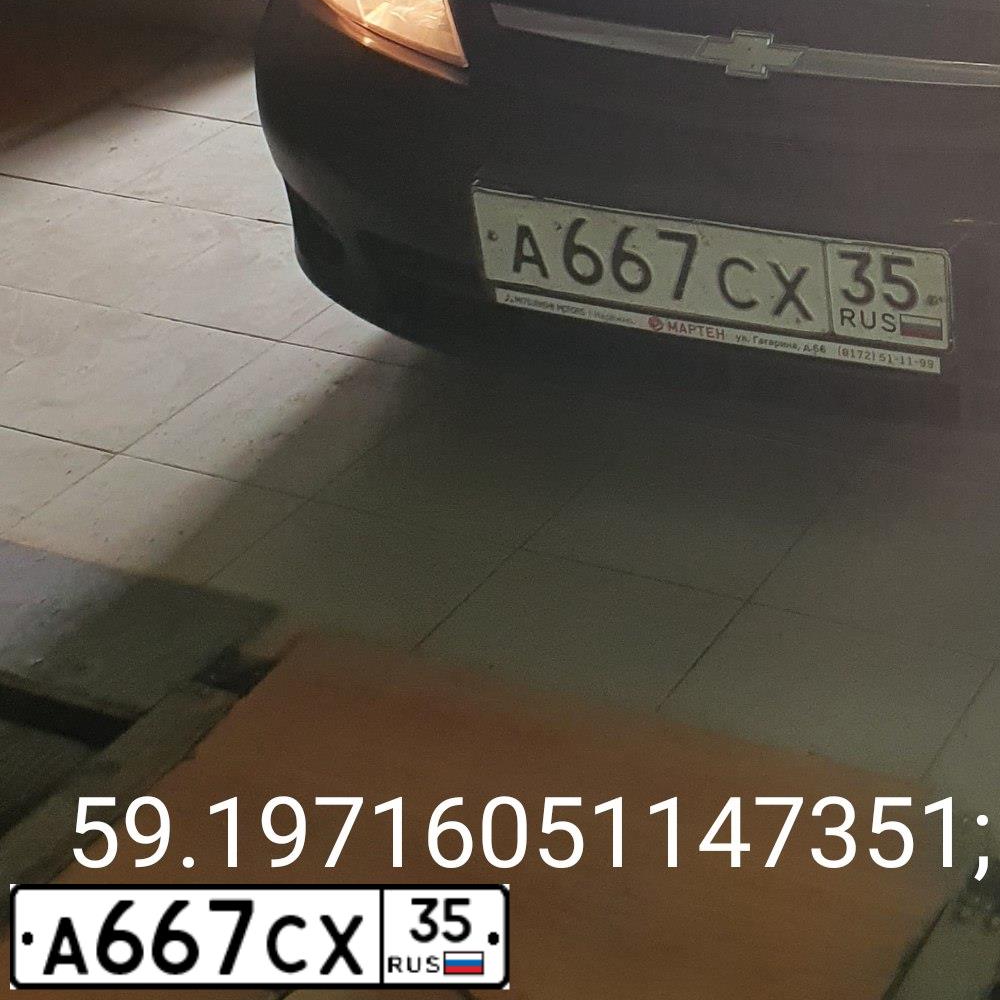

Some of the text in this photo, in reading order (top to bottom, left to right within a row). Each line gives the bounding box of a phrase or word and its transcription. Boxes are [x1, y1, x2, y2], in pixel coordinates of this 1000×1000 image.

[837, 250, 919, 311] 35
[667, 321, 726, 340] МАРТЕН
[839, 306, 898, 333] RUS
